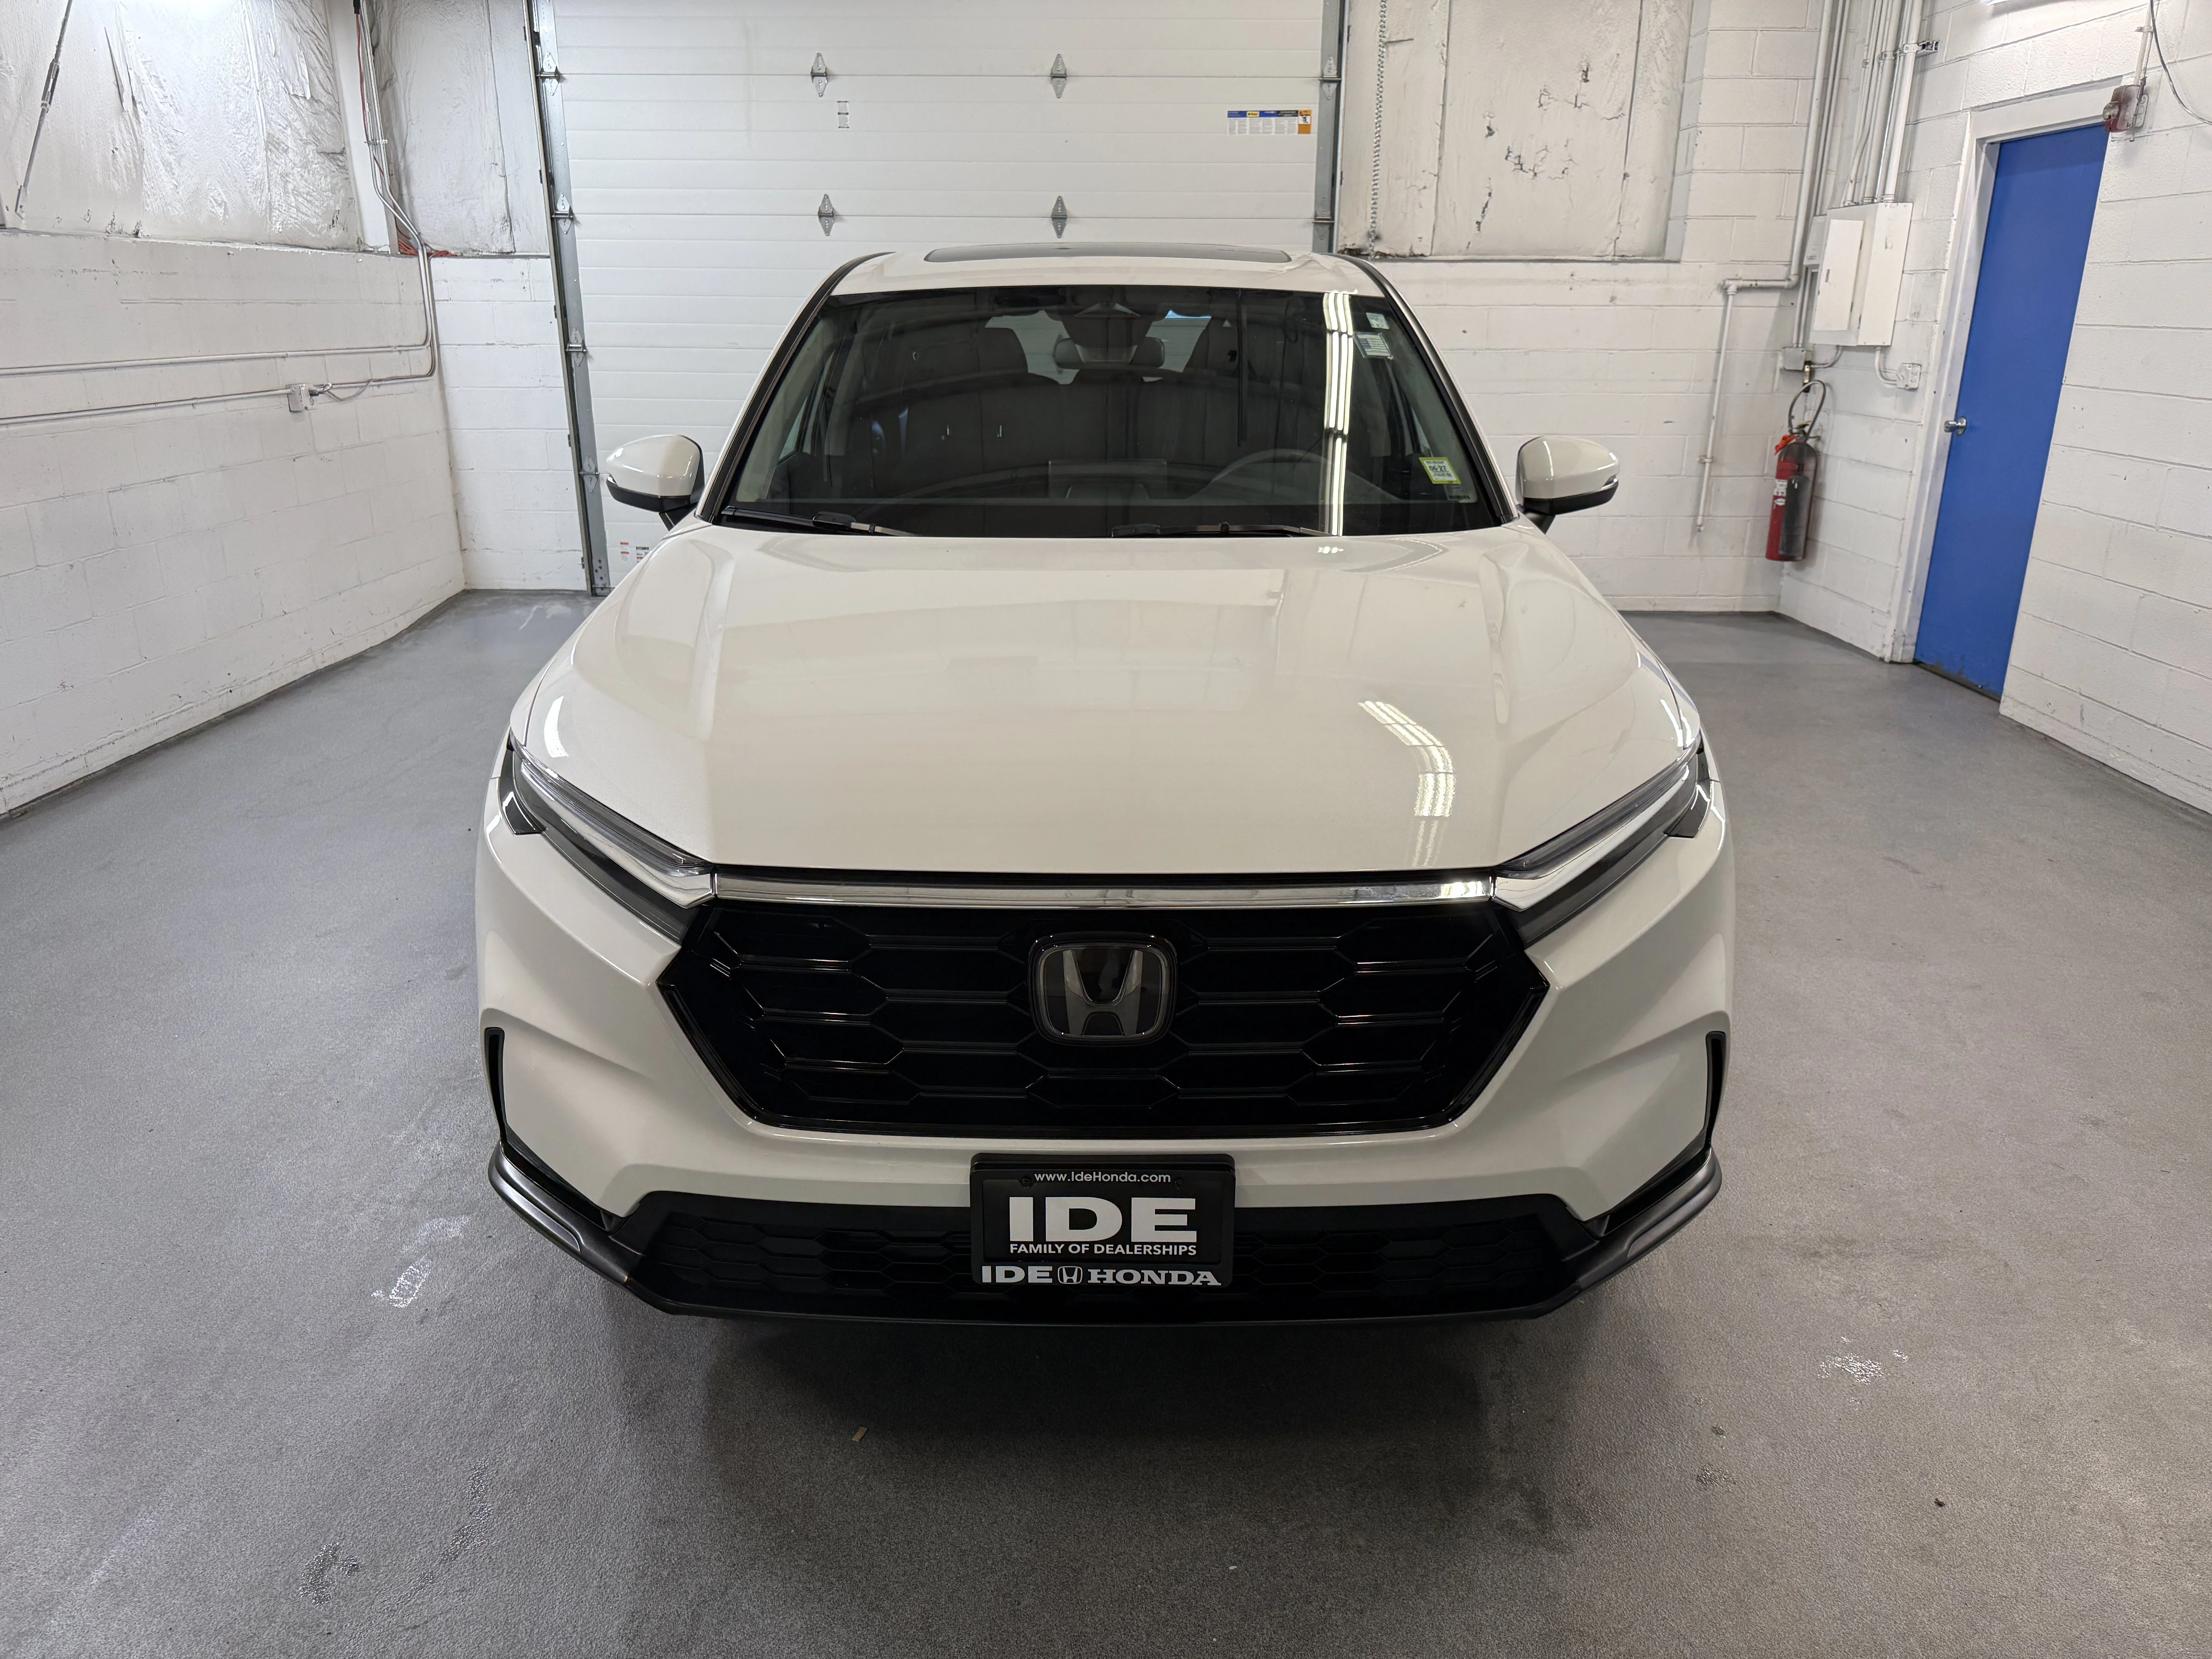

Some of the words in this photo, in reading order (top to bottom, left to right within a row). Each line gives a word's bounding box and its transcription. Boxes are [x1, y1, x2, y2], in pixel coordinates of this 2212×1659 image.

[1034, 1171, 1171, 1183] www.IdeHonda.com
[1009, 1197, 1197, 1243] IDE
[1010, 1243, 1065, 1254] FAMILY
[1068, 1244, 1089, 1254] OF
[1094, 1244, 1197, 1255] DEALERSHIPS
[982, 1266, 1053, 1283] IDE
[1087, 1269, 1221, 1286] HONDA
